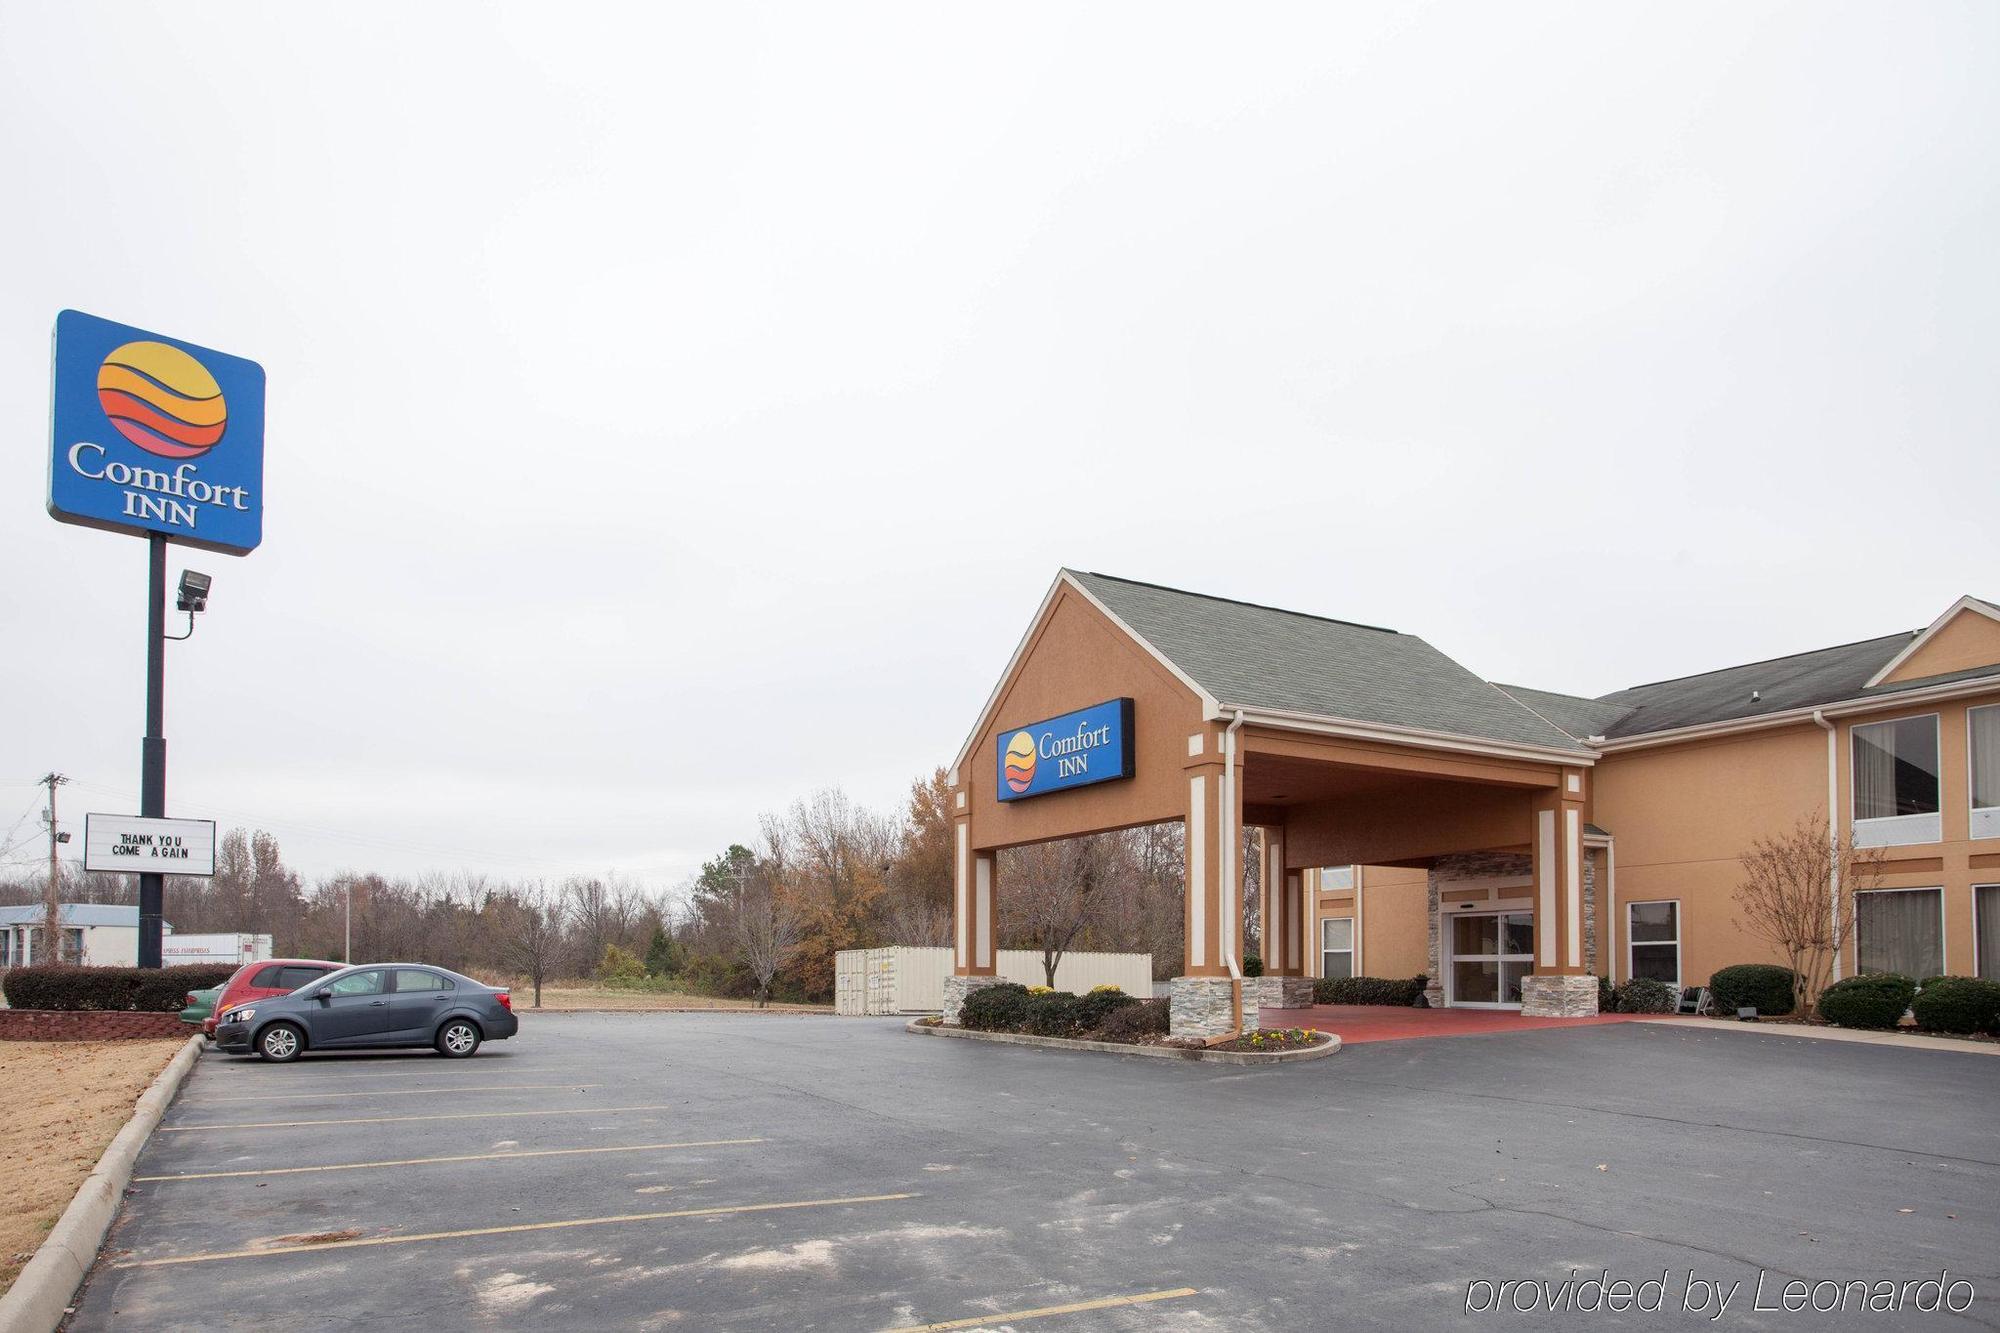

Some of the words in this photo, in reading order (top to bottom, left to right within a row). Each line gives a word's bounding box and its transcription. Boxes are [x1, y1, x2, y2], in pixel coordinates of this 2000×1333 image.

[68, 442, 249, 510] Comfort
[123, 490, 197, 528] INN
[1039, 721, 1110, 760] Comfort
[1059, 753, 1088, 779] INN
[112, 845, 140, 856] COME
[121, 834, 153, 845] THANK
[159, 836, 182, 847] YOU
